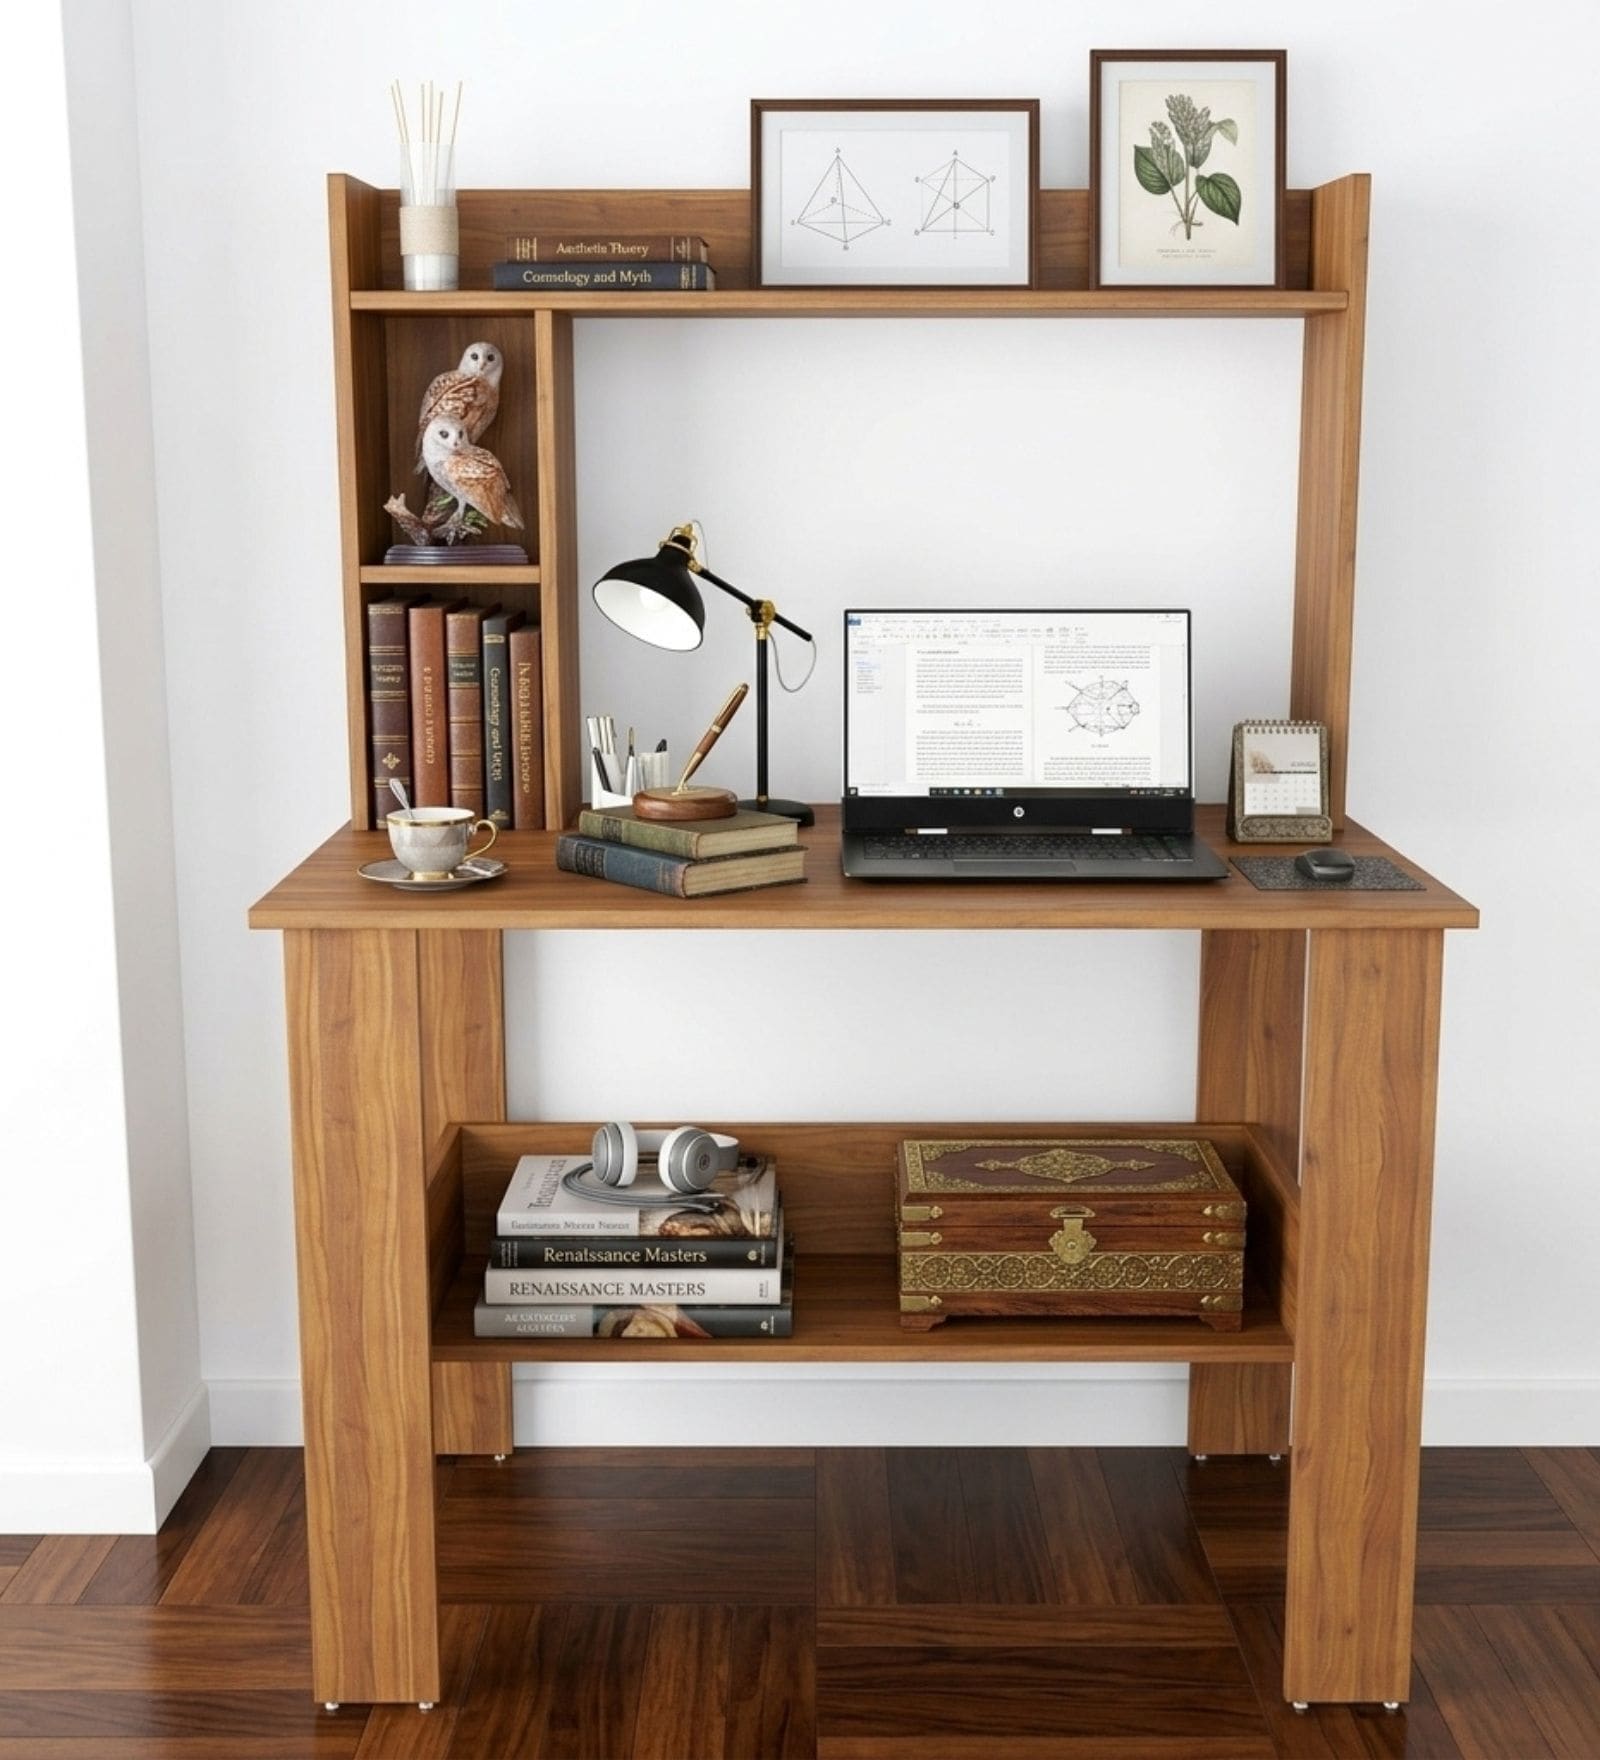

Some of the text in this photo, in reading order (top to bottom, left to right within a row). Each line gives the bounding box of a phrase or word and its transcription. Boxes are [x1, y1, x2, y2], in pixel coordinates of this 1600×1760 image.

[644, 1246, 708, 1263] Masters
[508, 1281, 706, 1297] RENAISSANCE MASTERS
